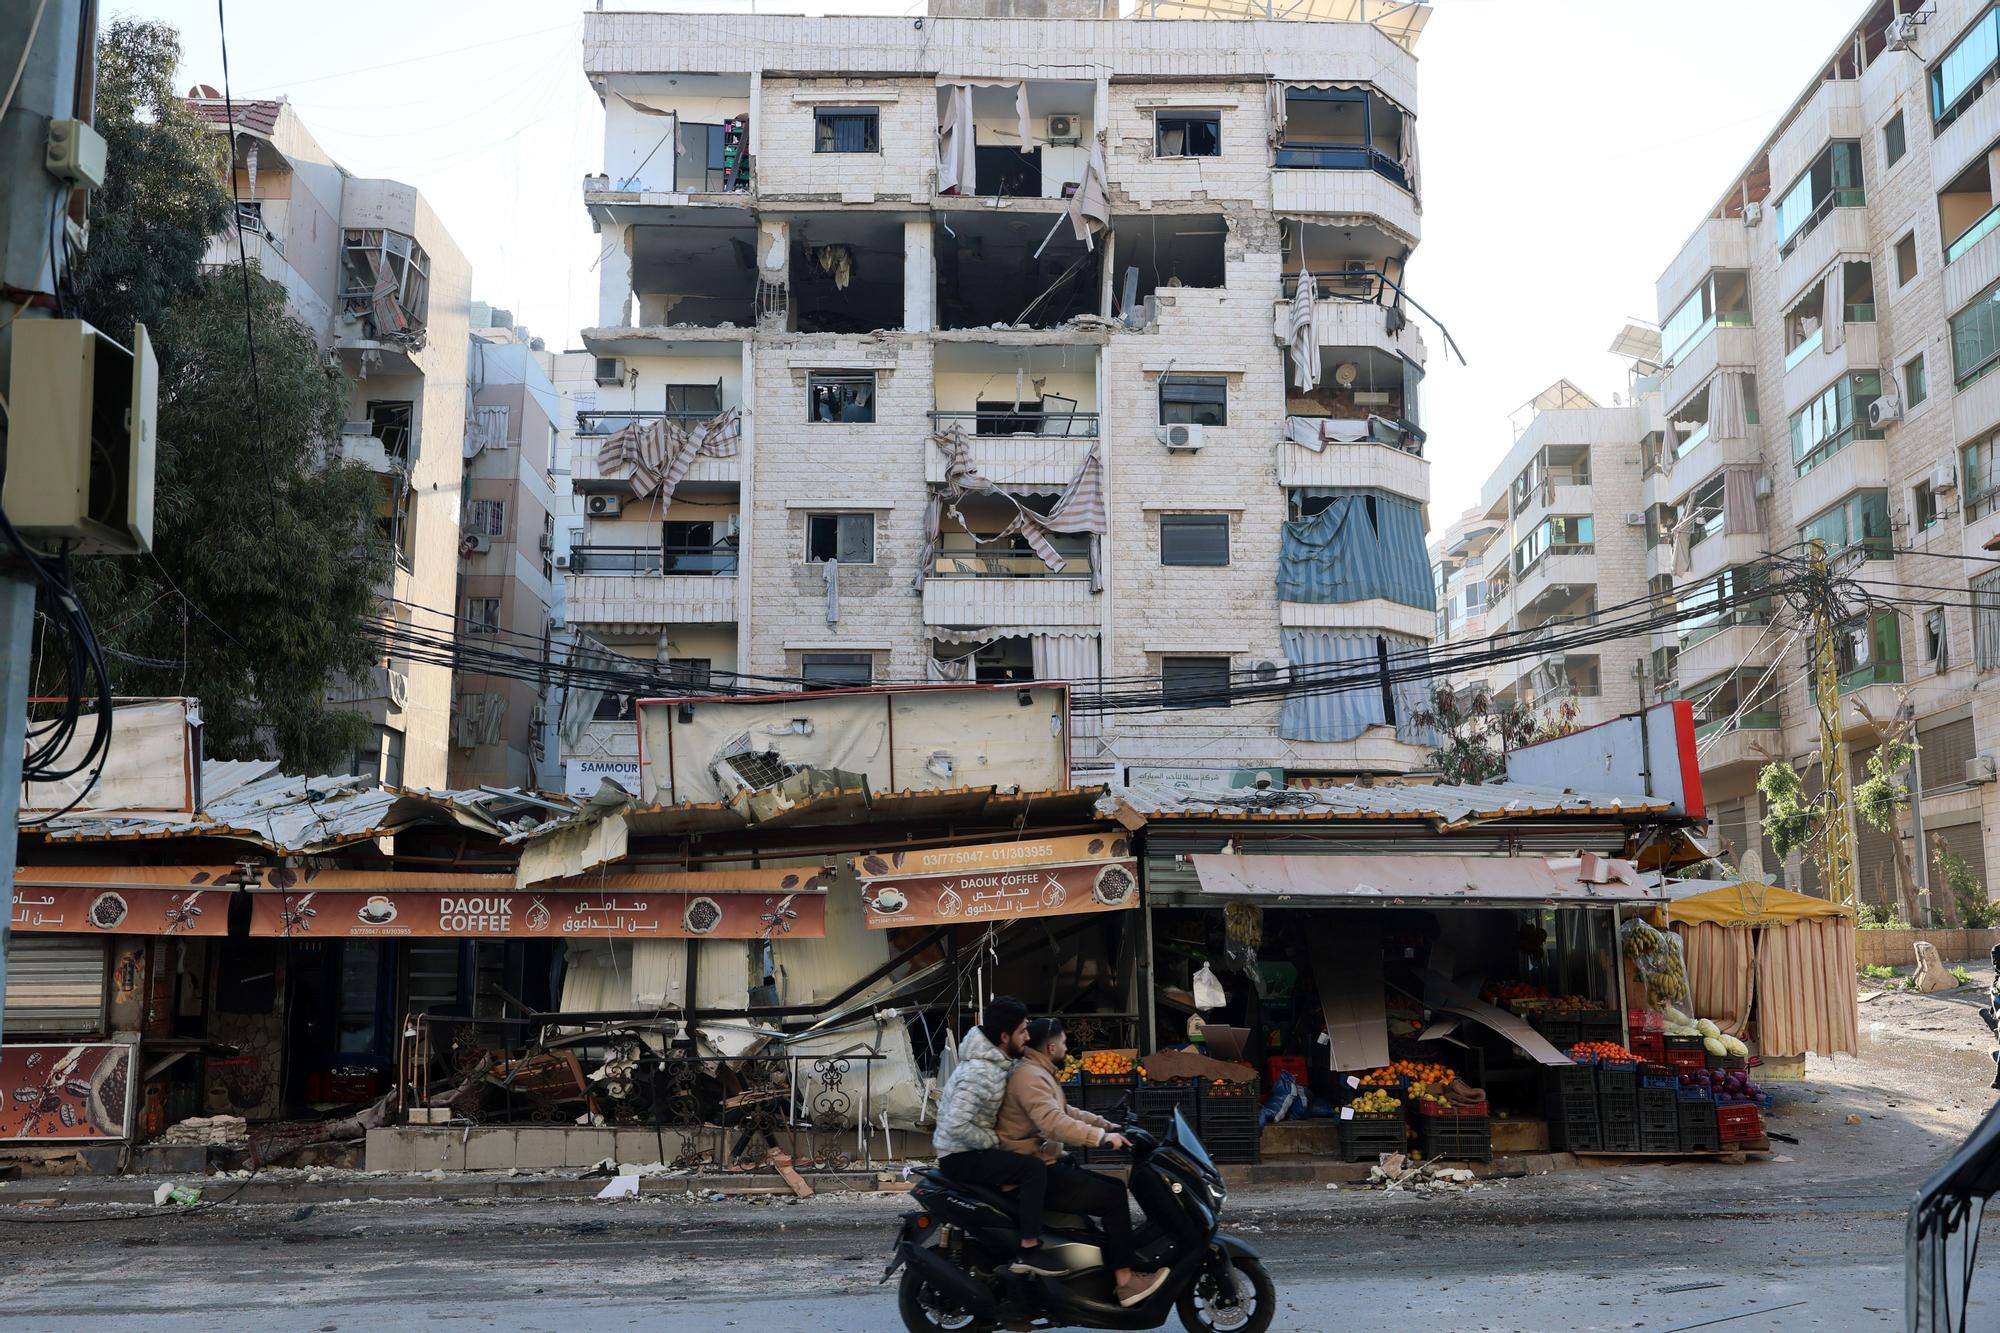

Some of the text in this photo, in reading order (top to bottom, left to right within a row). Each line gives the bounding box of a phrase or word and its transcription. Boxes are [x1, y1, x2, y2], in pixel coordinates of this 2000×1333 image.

[581, 763, 638, 773] SAMMOUR
[992, 845, 1053, 860] 01/303955
[961, 874, 1039, 889] DAOUK COFFEE
[12, 892, 55, 905] محام
[973, 887, 1030, 901] محامص
[440, 898, 512, 914] DAOUK
[575, 898, 648, 914] محامص
[964, 900, 1040, 916] بن الداعوق
[33, 912, 64, 926] بن
[439, 915, 511, 932] COFFEE
[562, 916, 658, 932] بن الداعوق
